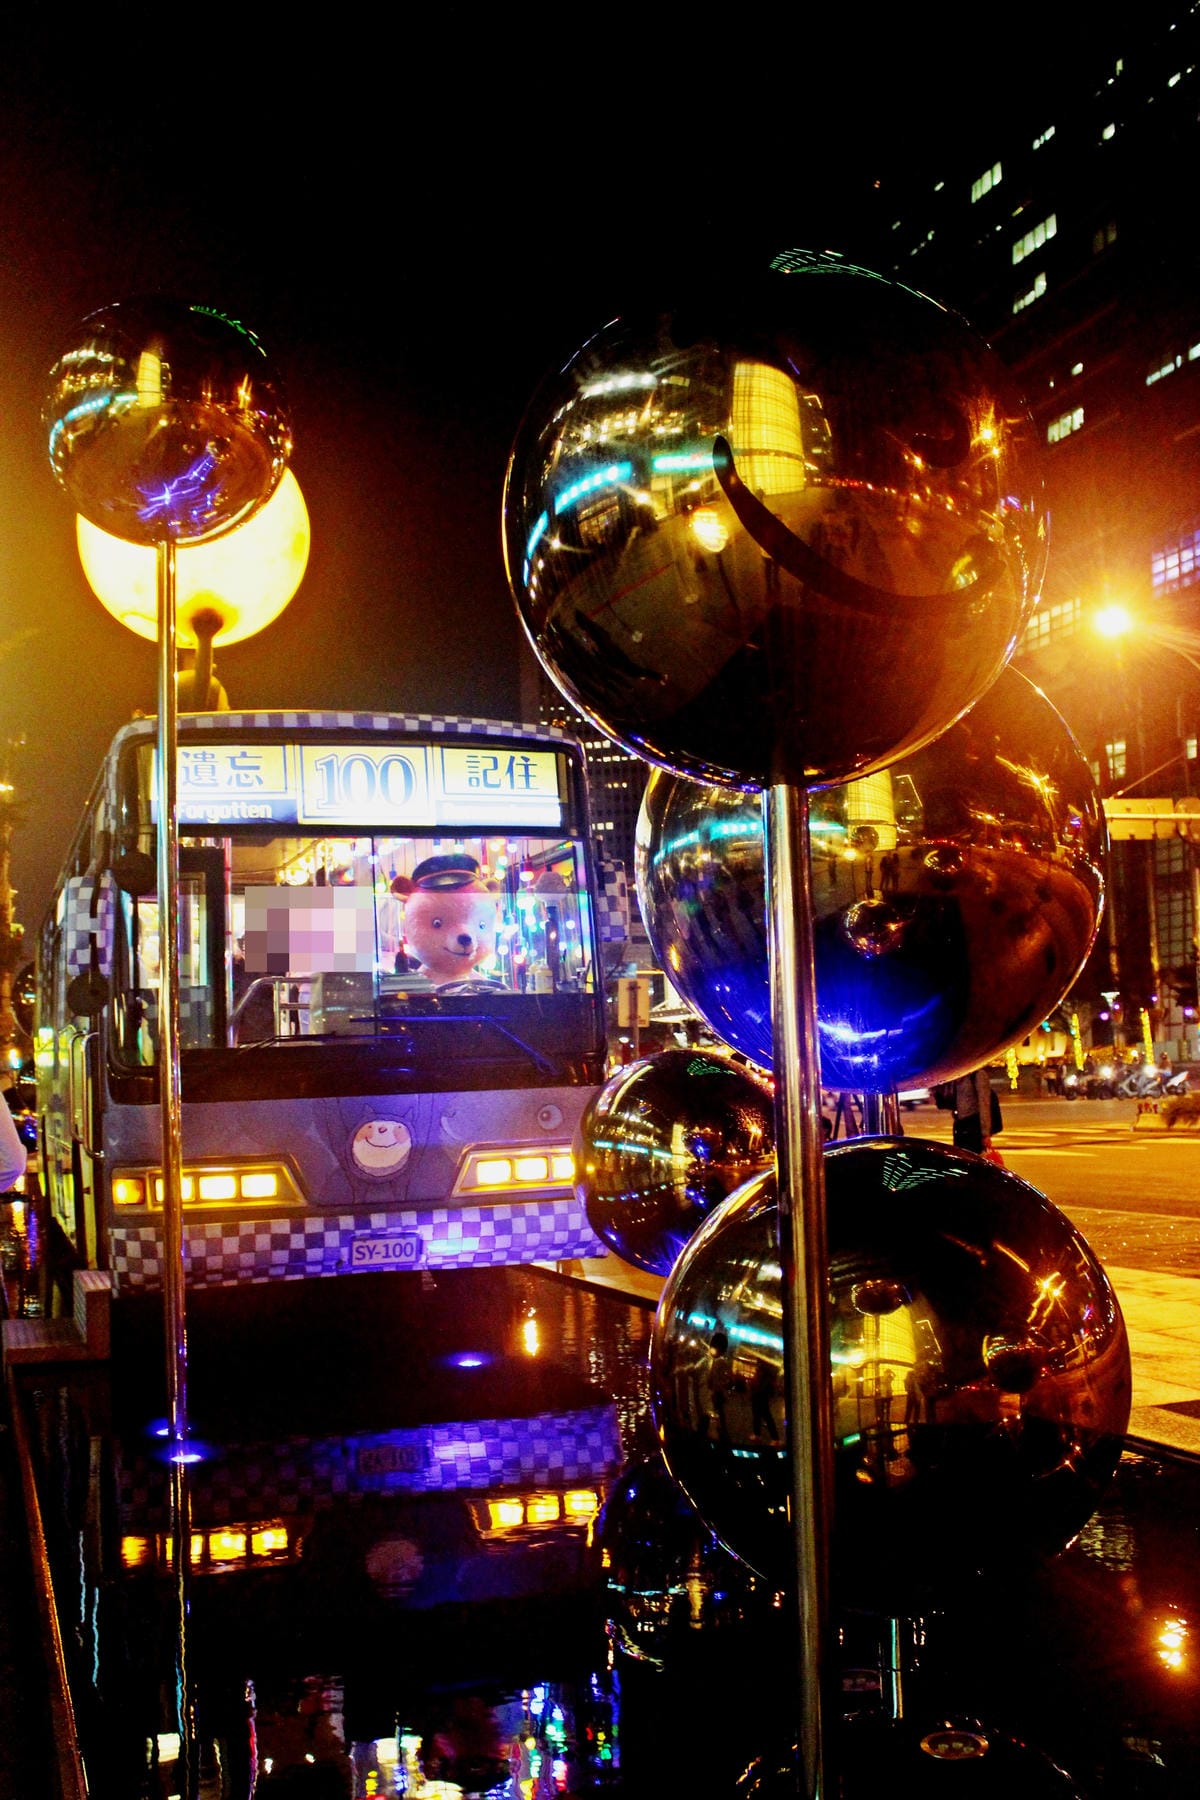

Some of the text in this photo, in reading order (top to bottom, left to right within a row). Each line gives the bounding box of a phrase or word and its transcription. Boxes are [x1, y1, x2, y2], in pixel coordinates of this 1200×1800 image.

[181, 751, 264, 788] 遺忘
[315, 753, 417, 809] 100
[466, 755, 539, 790] 記住
[177, 801, 273, 824] Forgotten
[355, 1242, 414, 1261] SY-100
